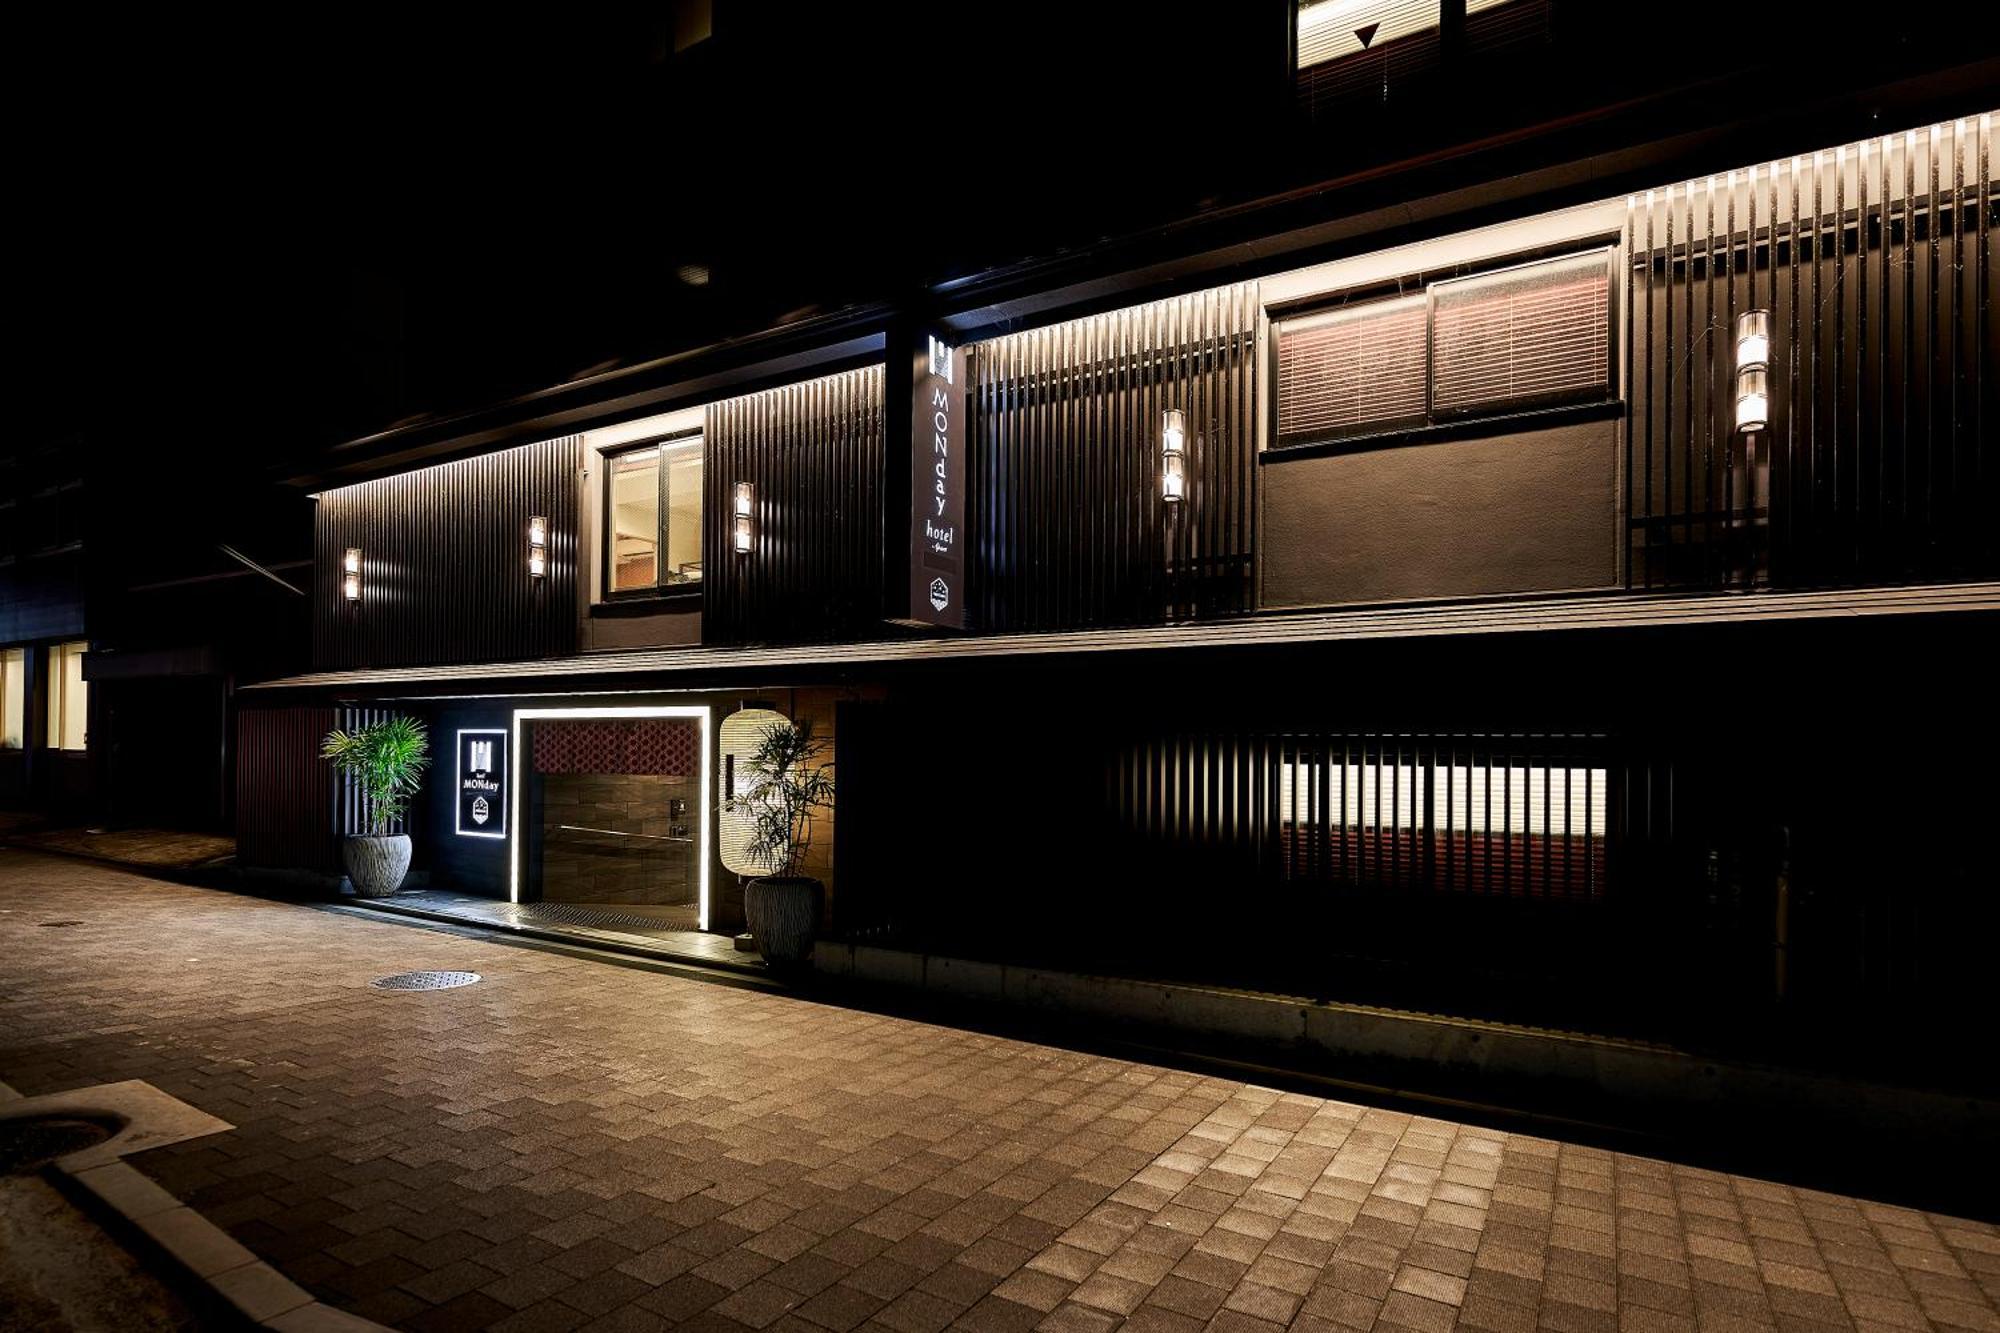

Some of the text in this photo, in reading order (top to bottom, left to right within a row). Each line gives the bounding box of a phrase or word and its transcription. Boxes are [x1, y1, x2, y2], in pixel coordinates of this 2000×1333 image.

[932, 388, 949, 516] MONday
[926, 519, 953, 545] hotel
[463, 779, 500, 793] MONday
